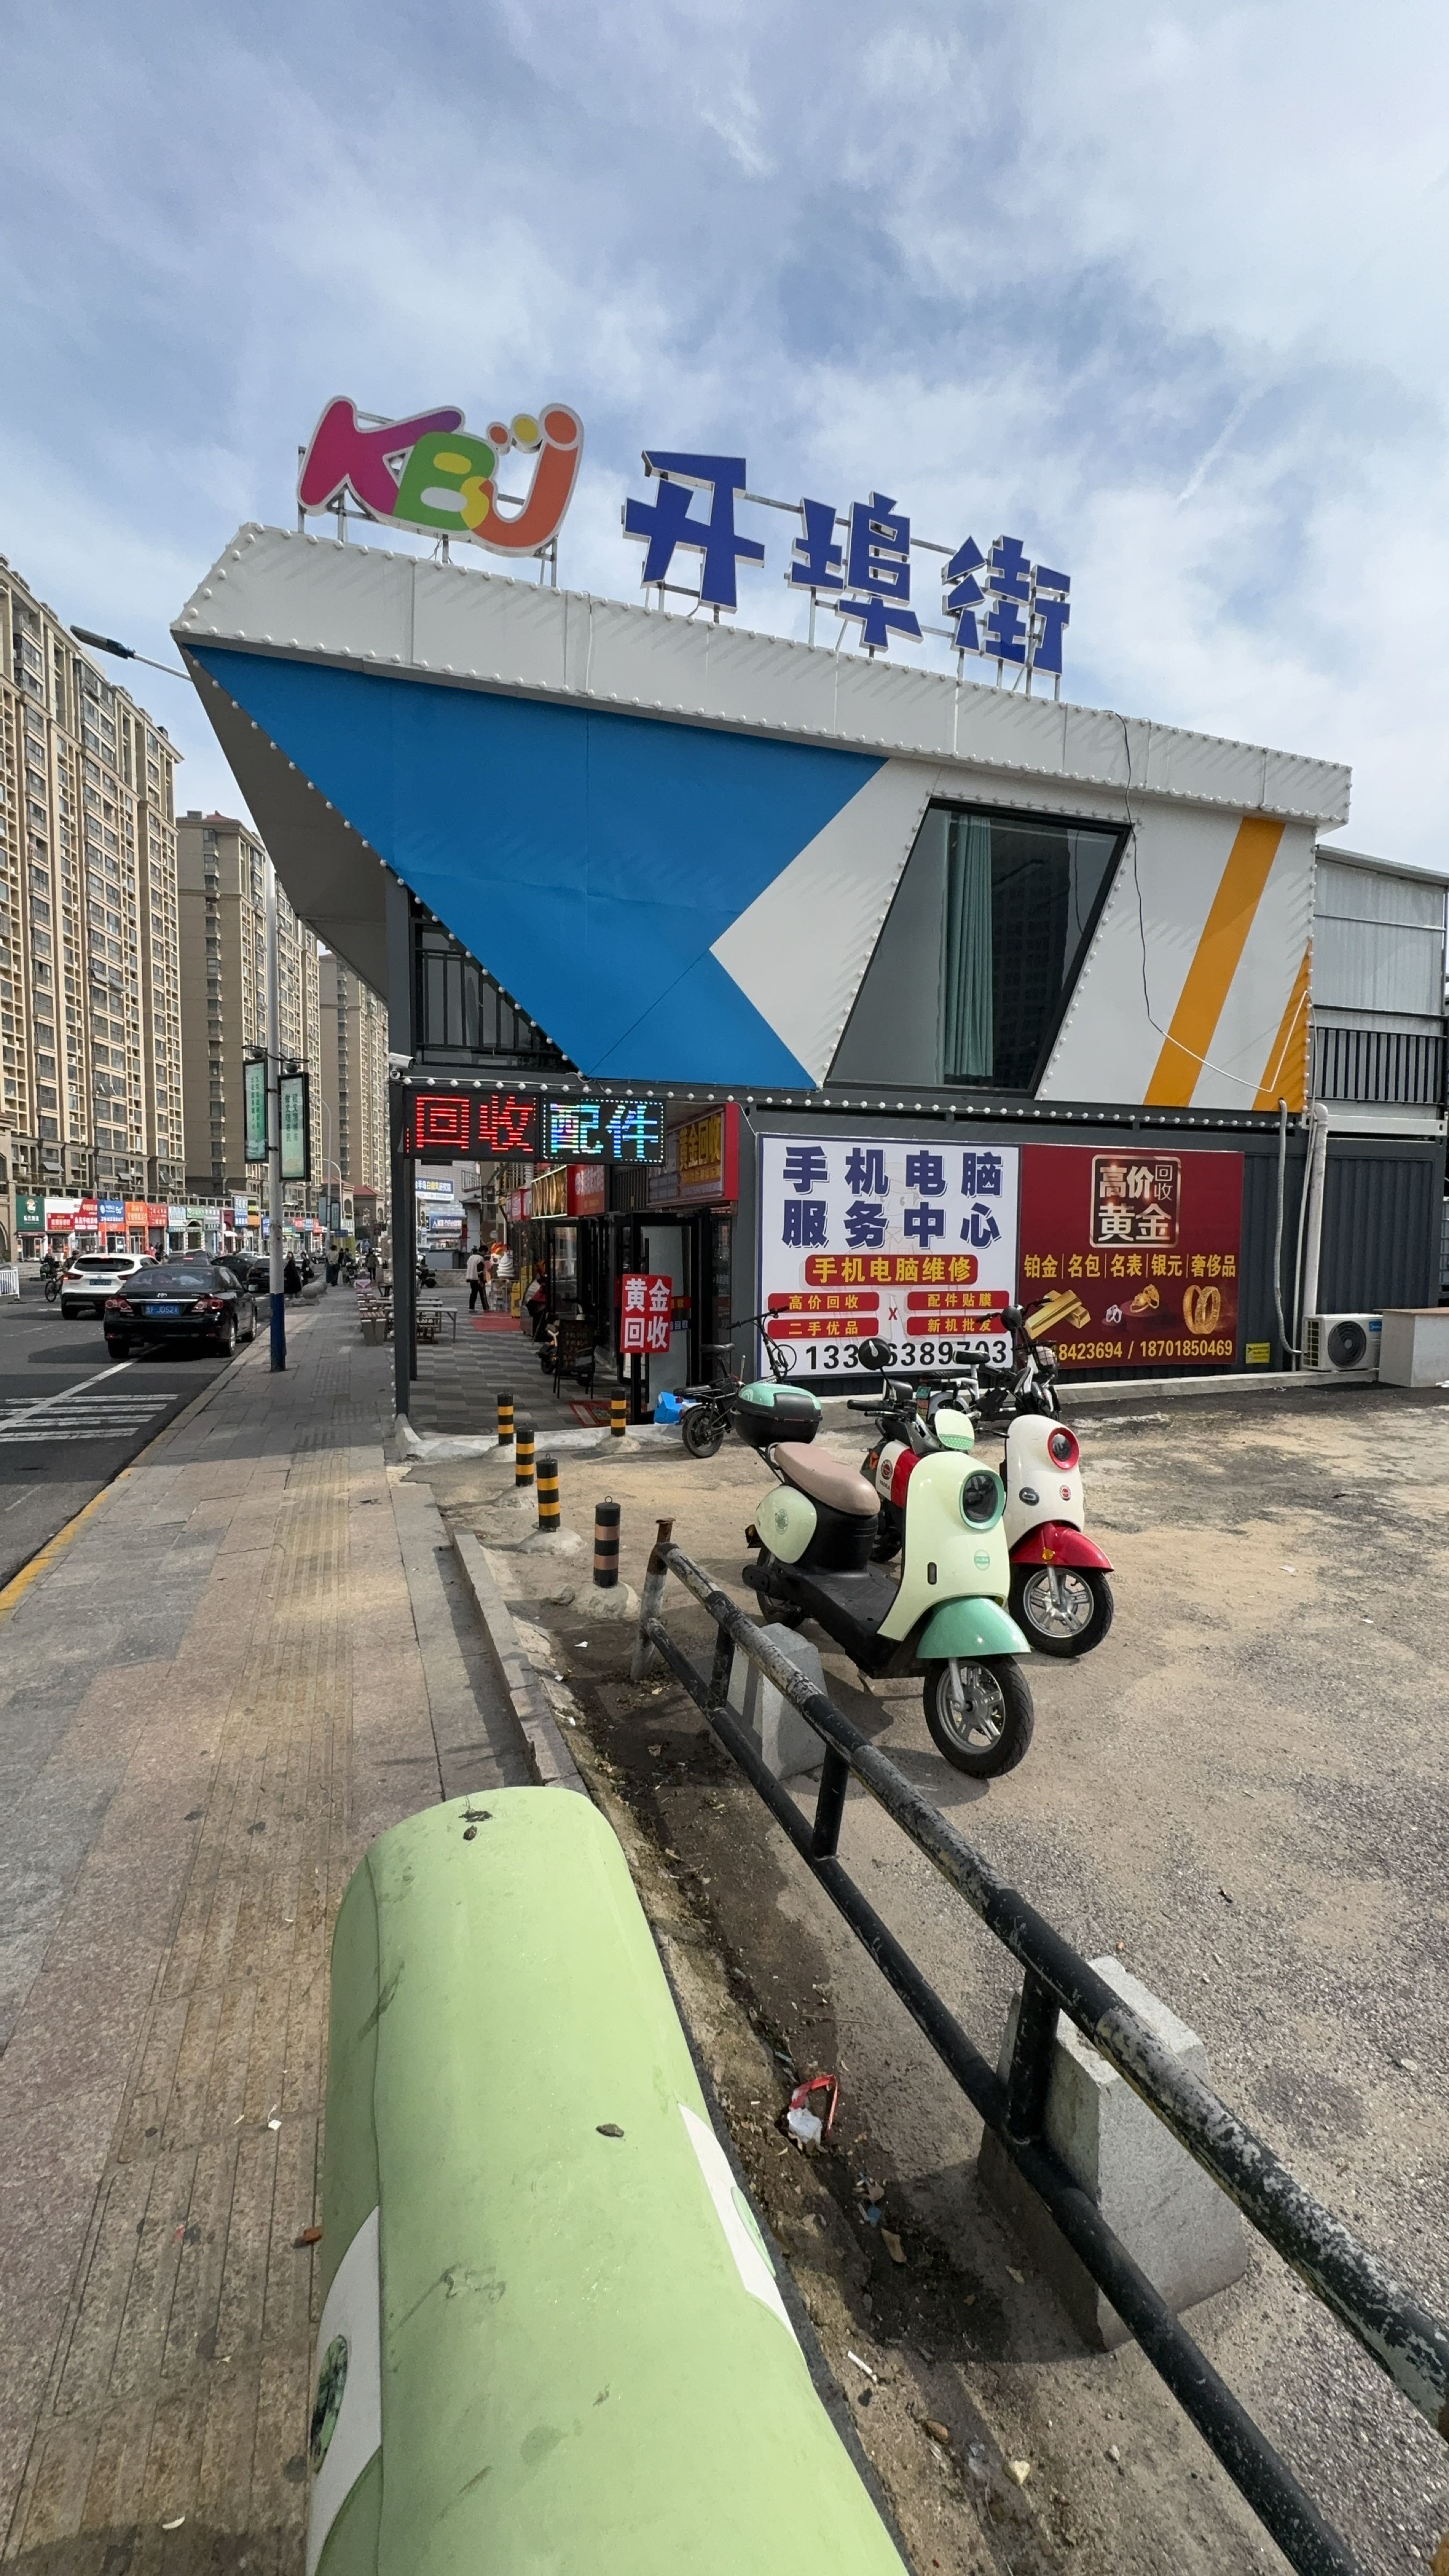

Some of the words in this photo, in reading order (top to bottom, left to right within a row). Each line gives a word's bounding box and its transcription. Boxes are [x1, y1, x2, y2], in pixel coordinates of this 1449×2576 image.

[622, 450, 1071, 676] 开埠街
[416, 1095, 533, 1152] 回收
[550, 1103, 659, 1158] 配件
[783, 1146, 1002, 1197] 手机电脑
[1099, 1165, 1154, 1198] 高价
[1154, 1165, 1173, 1201] 回收
[781, 1200, 1002, 1249] 服务中心
[1098, 1203, 1172, 1241] 黄金
[813, 1256, 971, 1284] 手机电脑维修
[1024, 1254, 1059, 1278] 铂金
[1067, 1253, 1100, 1278] 名包
[1110, 1253, 1143, 1278] 名表
[1151, 1253, 1182, 1277] 银元
[1191, 1253, 1236, 1277] 奢侈品
[625, 1277, 670, 1312] 黄金
[788, 1294, 859, 1311] 高价回收
[927, 1292, 992, 1308] 配件贴膜
[624, 1316, 669, 1349] 回收
[788, 1320, 859, 1336] 二手优品
[927, 1318, 992, 1333] 新机批发
[1140, 1340, 1233, 1357] 18701850469
